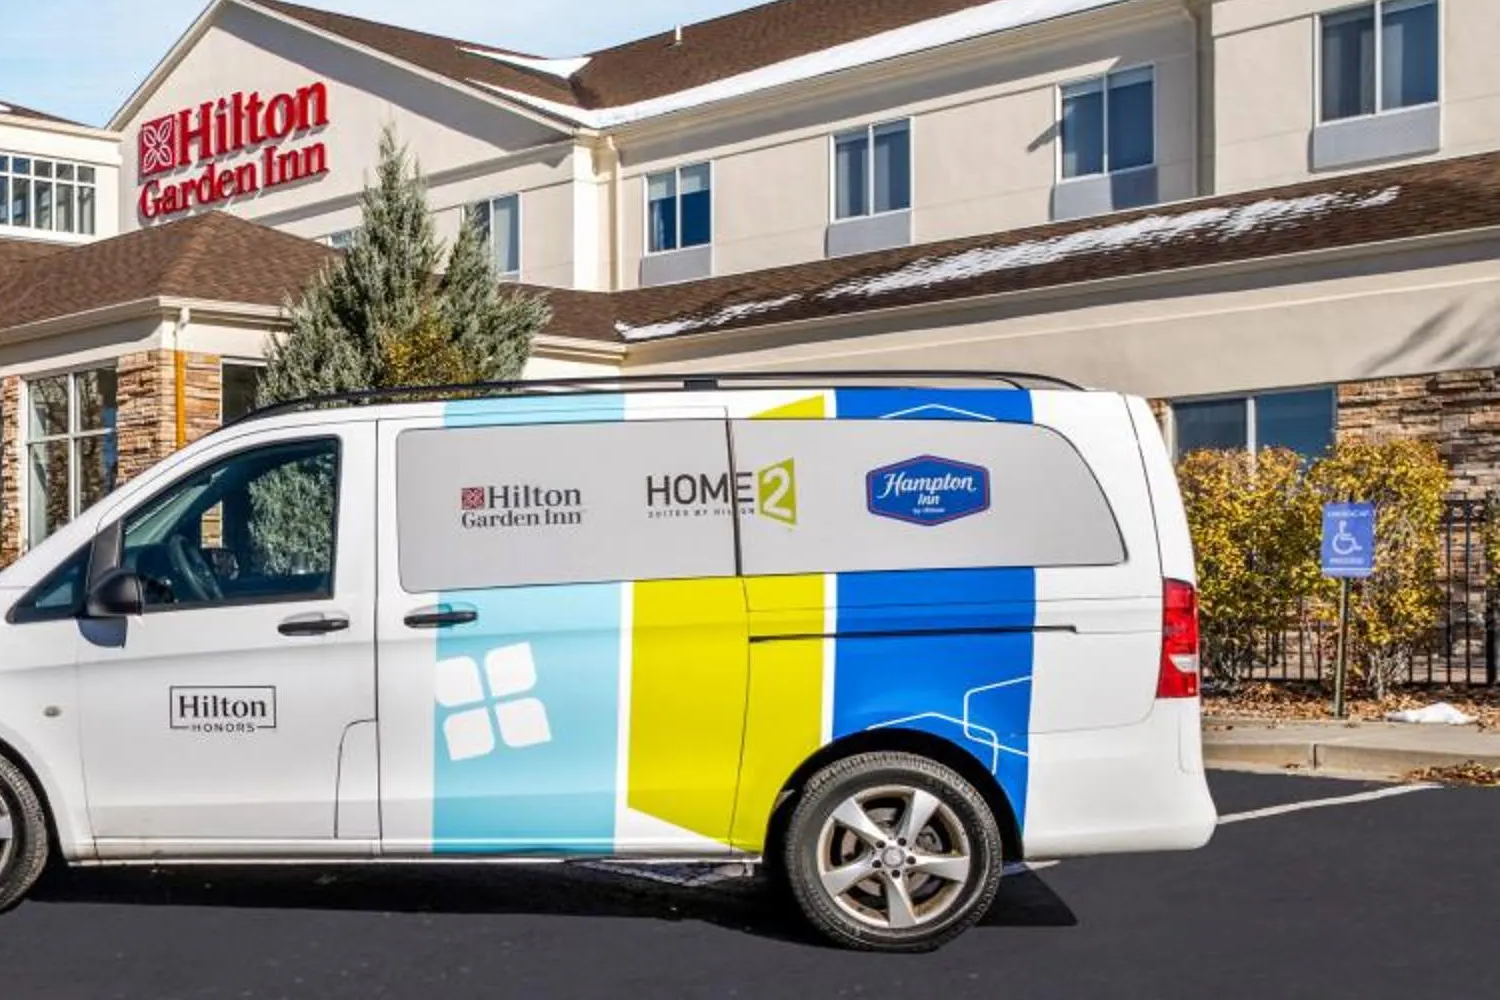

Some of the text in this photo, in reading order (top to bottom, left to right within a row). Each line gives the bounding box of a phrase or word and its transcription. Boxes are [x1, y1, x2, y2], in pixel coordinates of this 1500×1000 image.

[178, 81, 329, 167] Hilton
[140, 142, 329, 219] Garden Inn
[488, 485, 581, 508] Hilton
[876, 471, 977, 499] Hampton
[713, 506, 755, 516] HILON
[917, 493, 941, 506] Inn
[461, 508, 582, 529] Garden Inn
[179, 695, 266, 718] Hilton
[191, 722, 256, 734] HONORS
